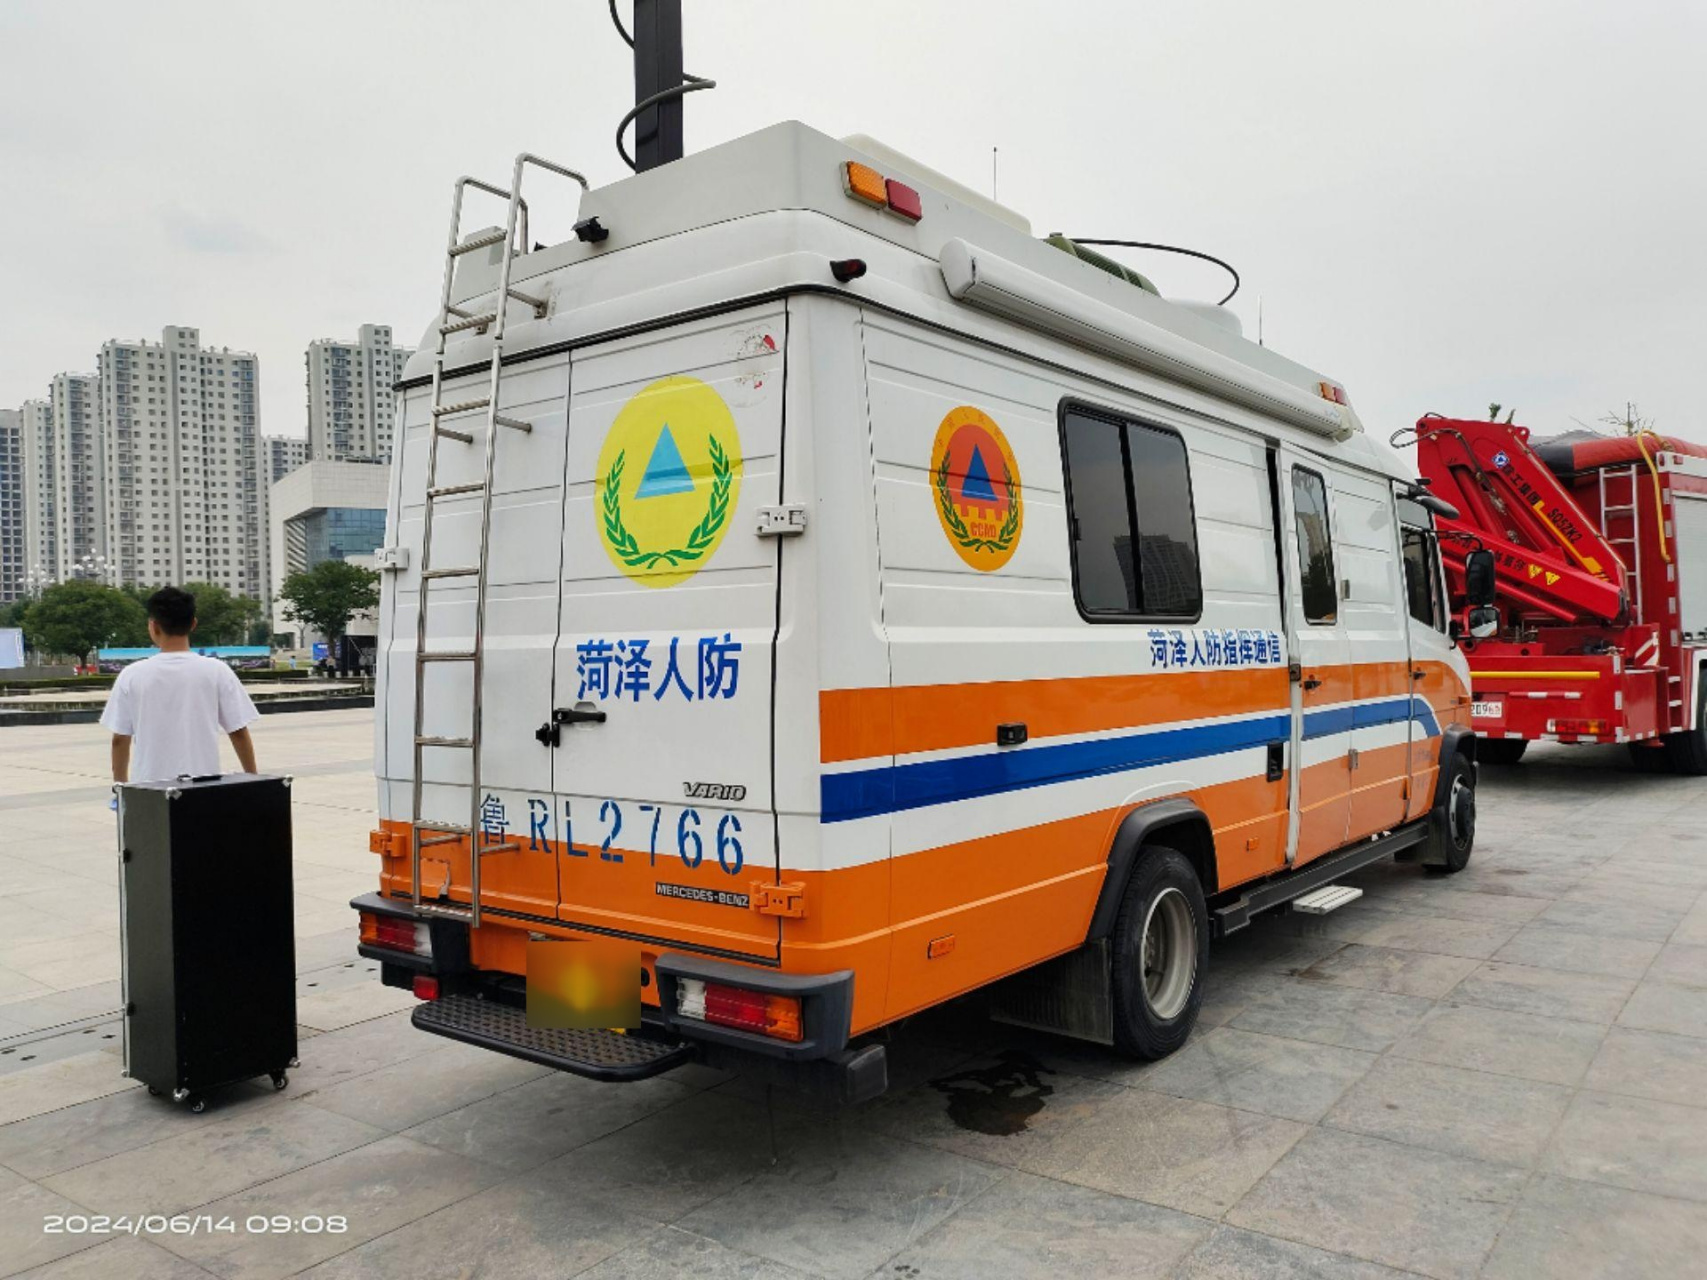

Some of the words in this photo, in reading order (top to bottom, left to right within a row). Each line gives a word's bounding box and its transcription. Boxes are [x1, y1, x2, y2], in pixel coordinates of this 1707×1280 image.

[1147, 628, 1281, 669] 菏泽人防指挥通信
[576, 632, 742, 702] 菏泽人防
[683, 782, 747, 801] VARIO
[656, 883, 749, 908] MERCEDES-BENZ
